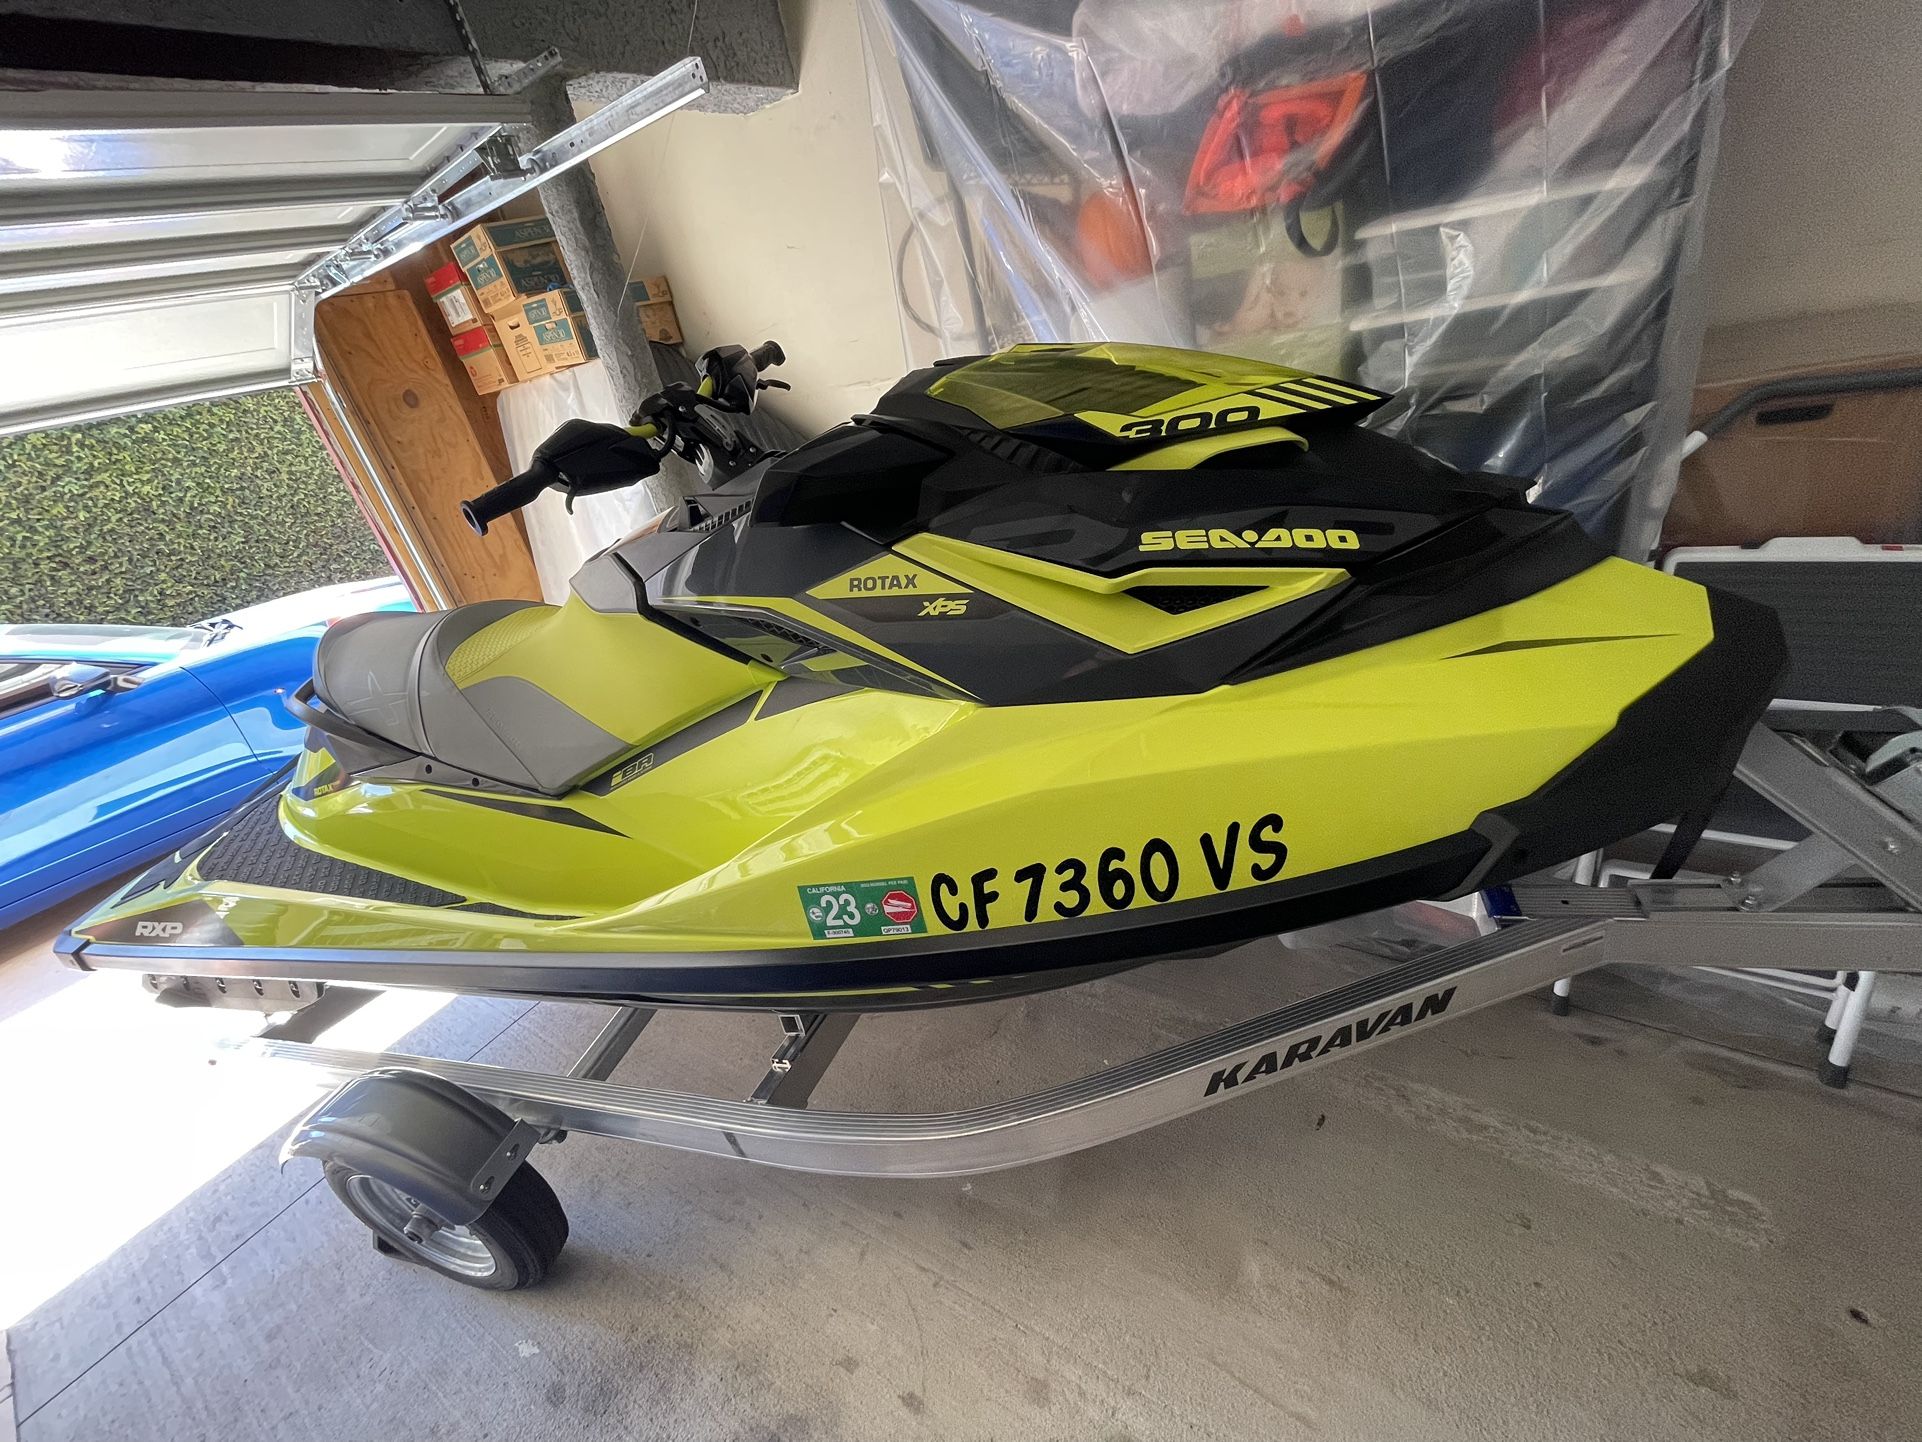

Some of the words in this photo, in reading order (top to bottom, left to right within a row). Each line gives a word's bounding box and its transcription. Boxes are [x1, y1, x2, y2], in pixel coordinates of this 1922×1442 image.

[1120, 405, 1261, 439] 300
[849, 573, 918, 592] ROTAX
[917, 597, 970, 617] XPS
[931, 867, 999, 931] CF
[1014, 837, 1179, 918] 7360
[1200, 813, 1288, 891] VS
[807, 885, 846, 894] CALIFORNIA
[820, 893, 861, 926] 23
[135, 921, 183, 938] RXP
[1204, 986, 1458, 1098] KARAVAN
